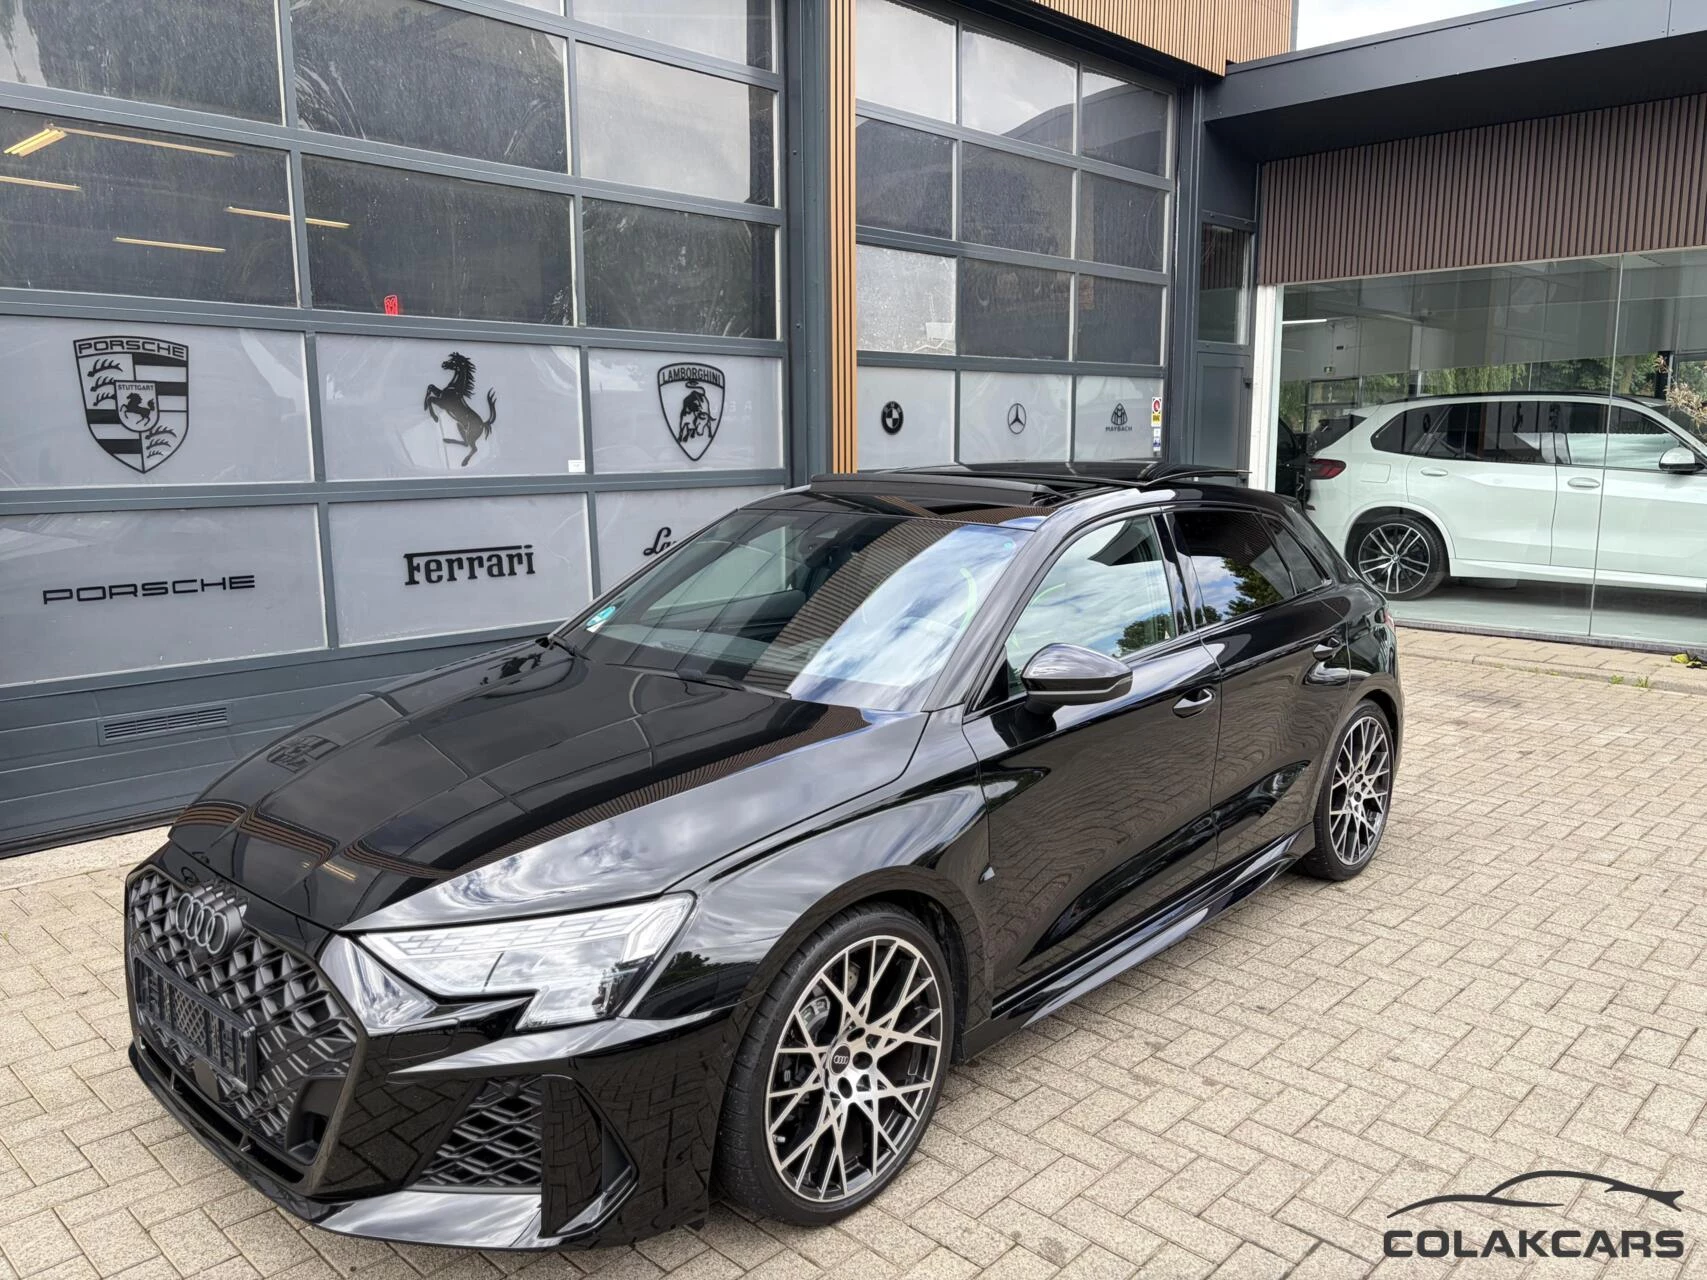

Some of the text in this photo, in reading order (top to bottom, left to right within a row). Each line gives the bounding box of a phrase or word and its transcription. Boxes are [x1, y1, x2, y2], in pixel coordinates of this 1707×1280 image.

[78, 340, 184, 358] PORSCHE
[662, 367, 721, 385] LAMBORGHINI
[403, 544, 536, 586] Ferrari
[43, 575, 255, 604] PORSCHE
